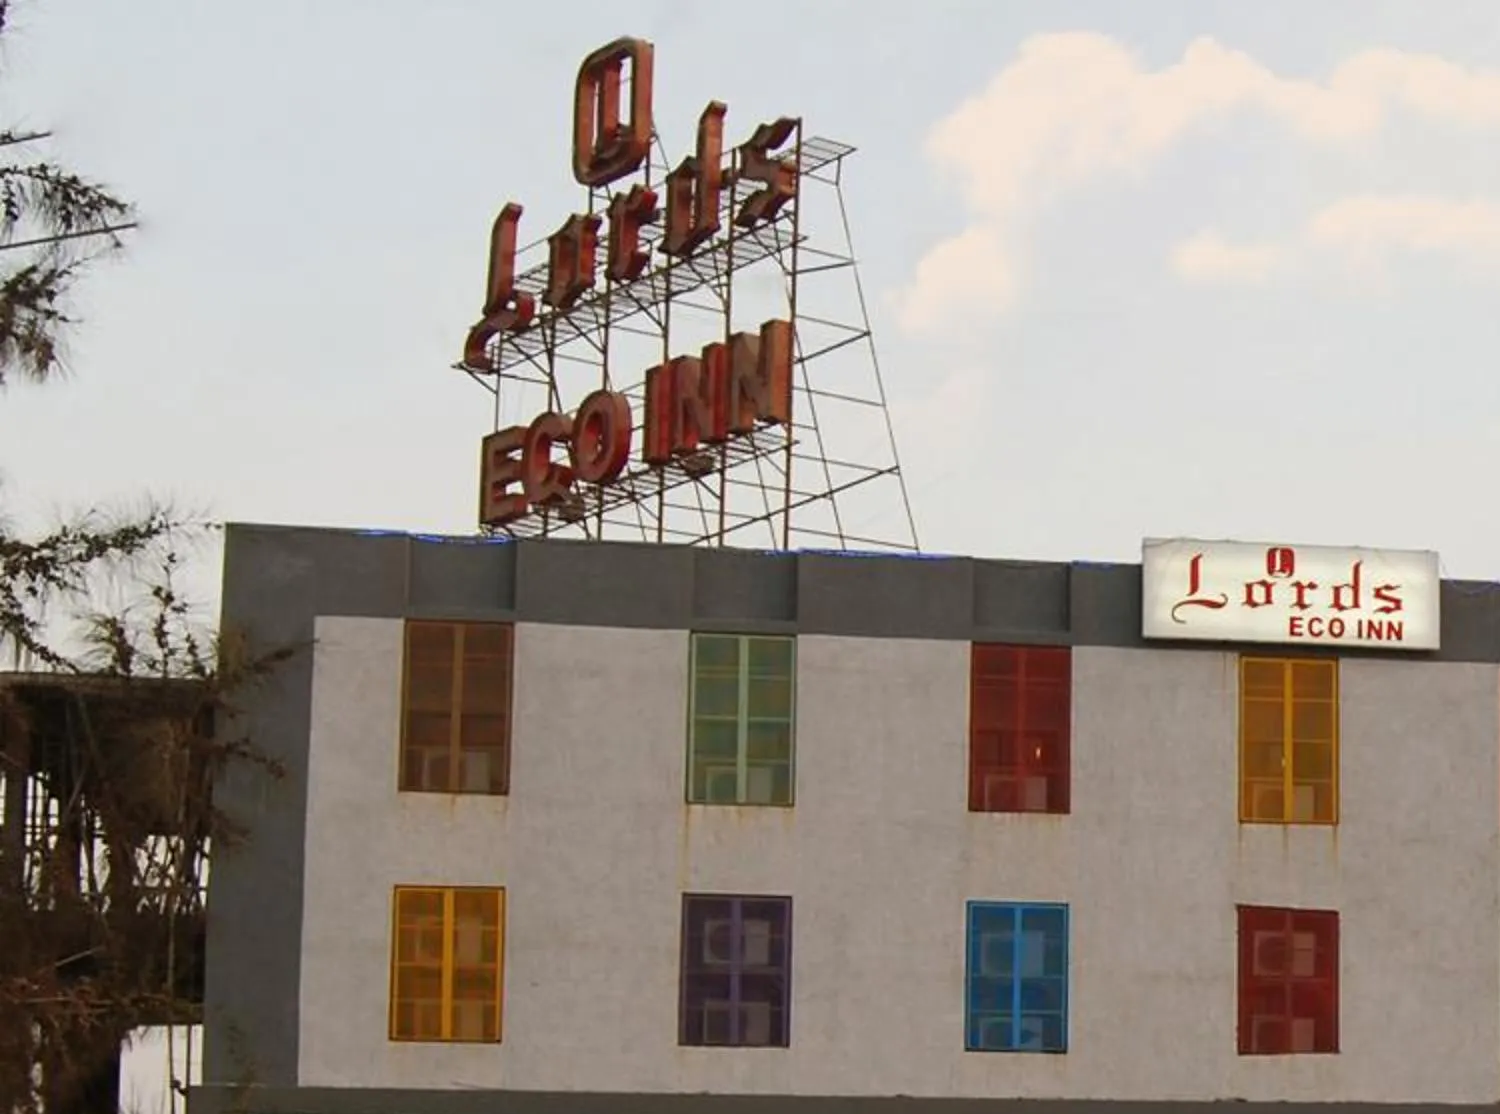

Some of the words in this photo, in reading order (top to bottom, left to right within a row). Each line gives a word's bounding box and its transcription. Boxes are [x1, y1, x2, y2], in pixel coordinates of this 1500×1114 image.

[464, 101, 800, 373] Lords
[479, 389, 632, 524] ECO
[643, 319, 793, 464] INN
[1171, 553, 1402, 623] Lords
[1289, 617, 1345, 638] ECO
[1357, 620, 1404, 641] INN
